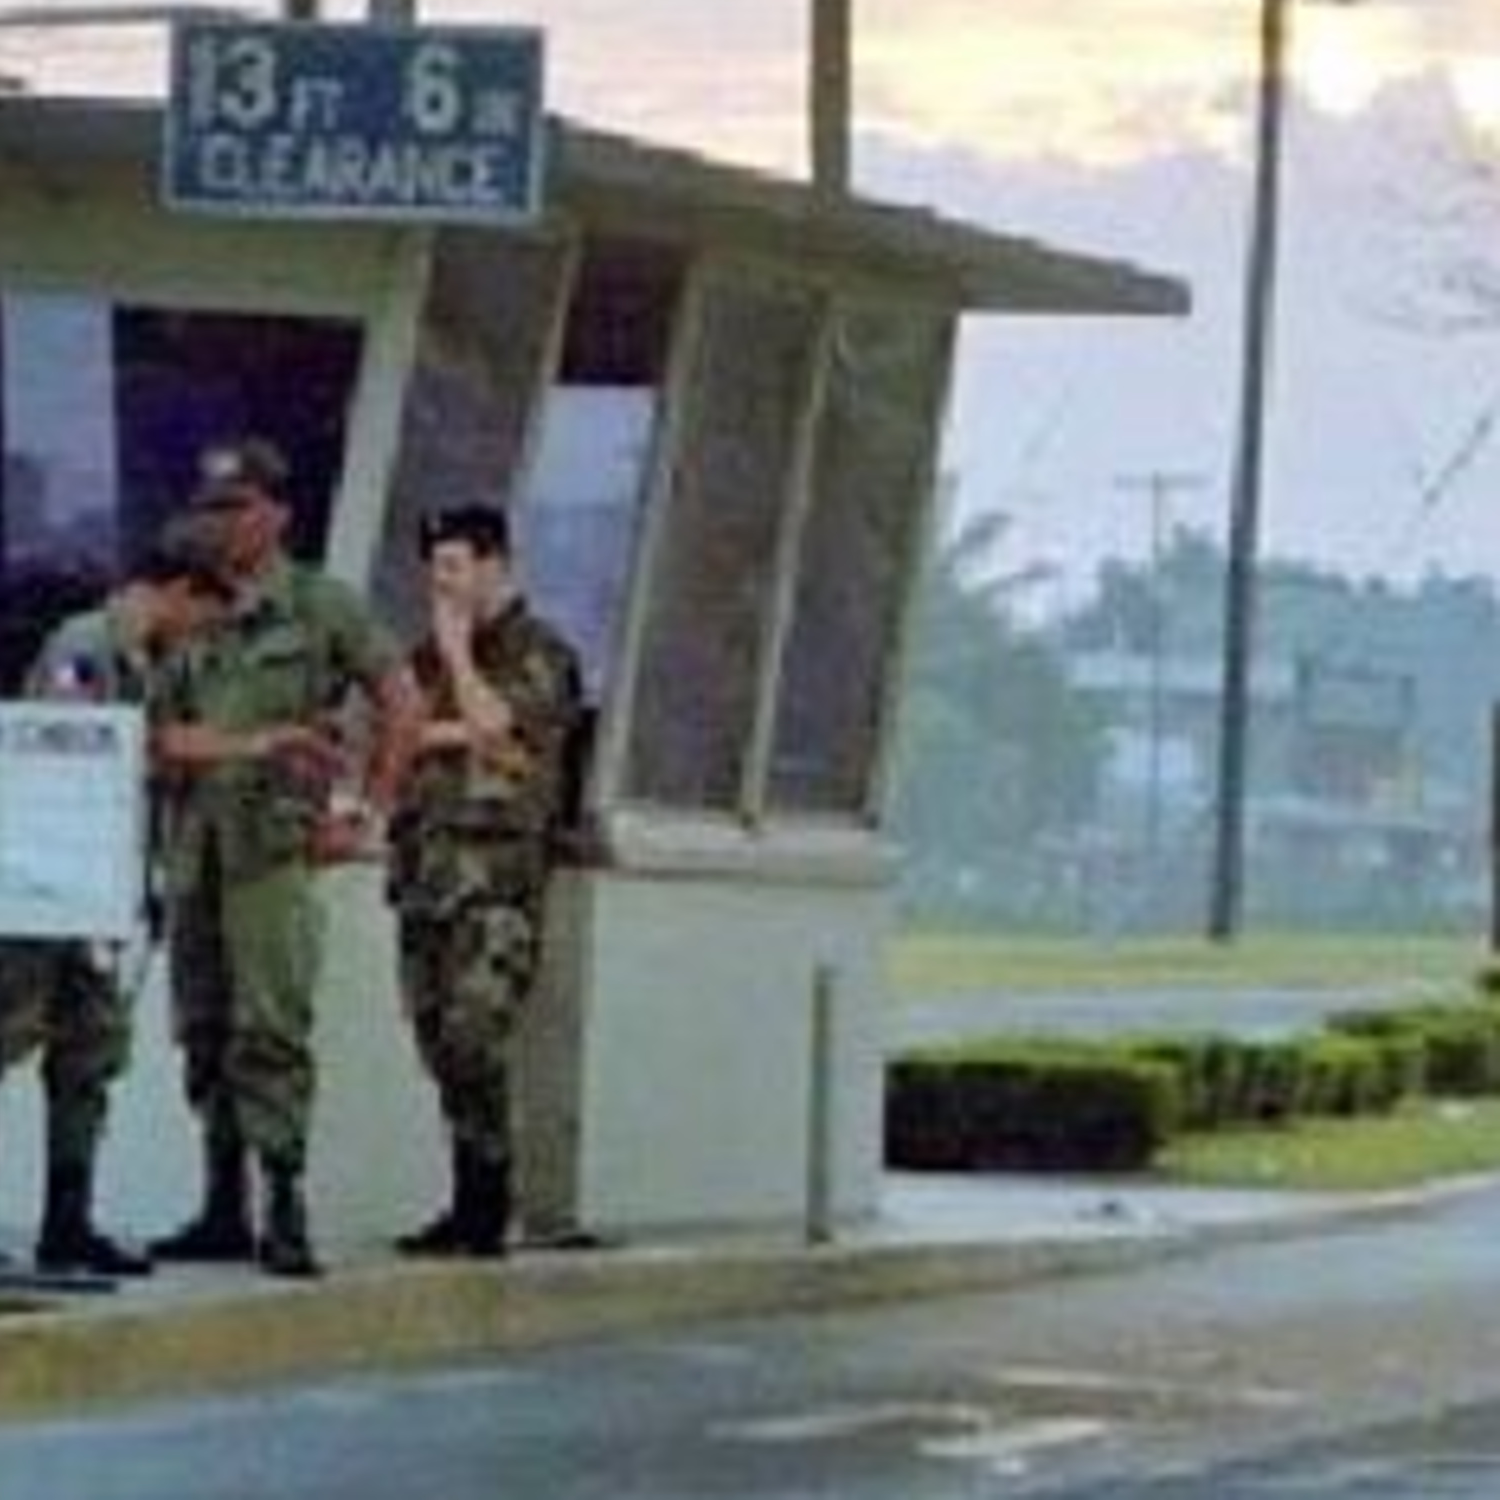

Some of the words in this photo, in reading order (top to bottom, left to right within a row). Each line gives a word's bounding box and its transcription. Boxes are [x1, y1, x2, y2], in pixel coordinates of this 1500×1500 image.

[188, 34, 278, 130] 13
[406, 43, 461, 134] 6
[200, 130, 511, 203] CLEARANCE
